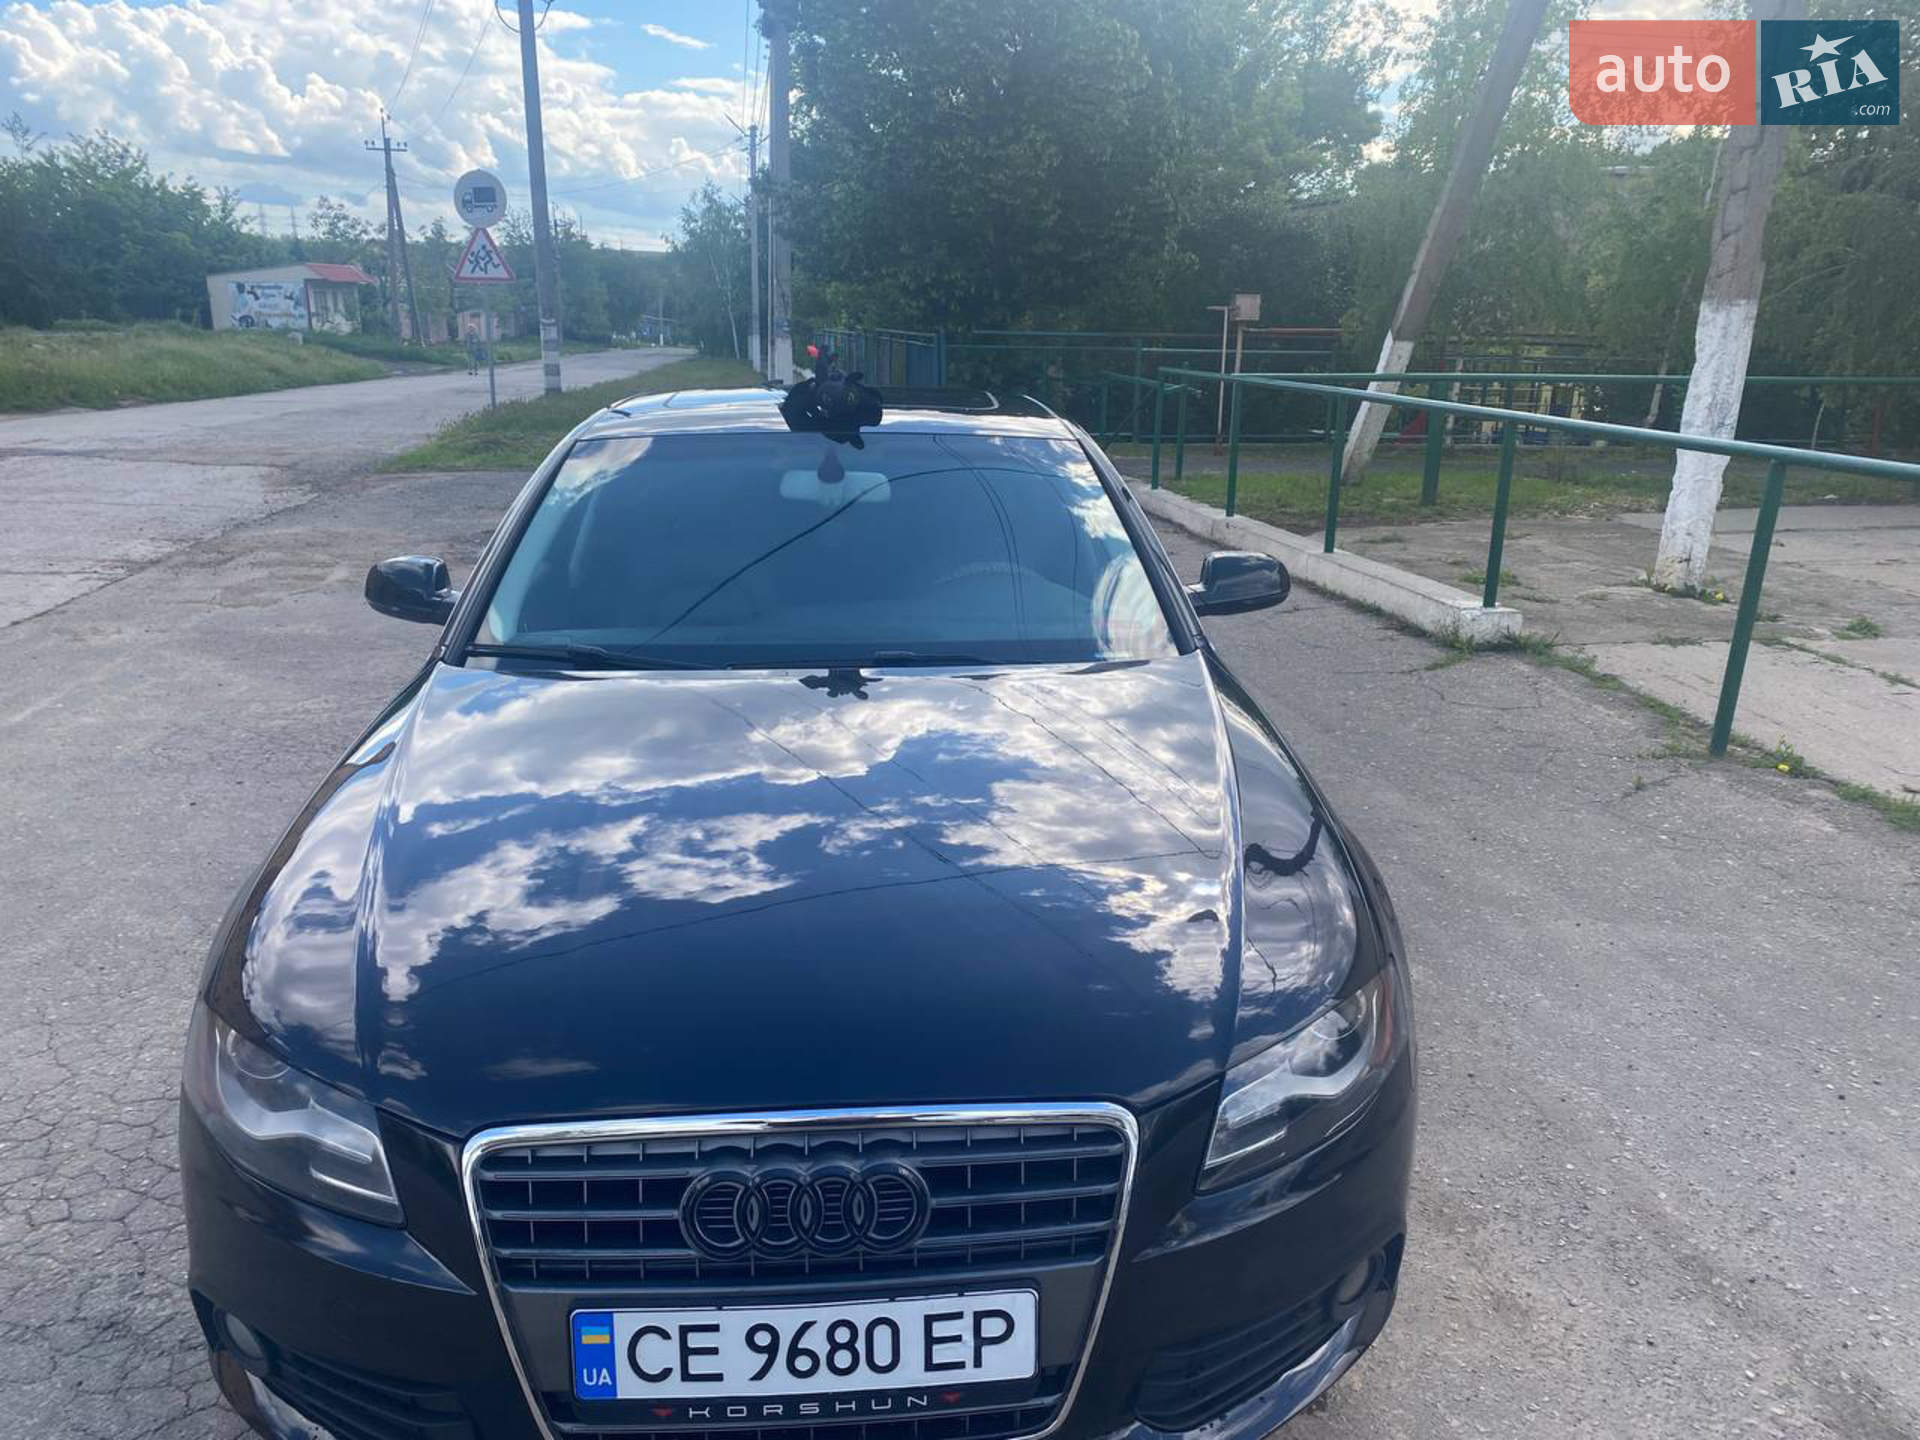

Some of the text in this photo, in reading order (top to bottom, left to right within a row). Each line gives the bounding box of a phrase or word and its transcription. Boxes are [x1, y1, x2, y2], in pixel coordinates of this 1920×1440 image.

[626, 1309, 1016, 1384] CE 9680 EP
[583, 1367, 613, 1387] UA
[689, 1394, 929, 1419] KORSHUN
